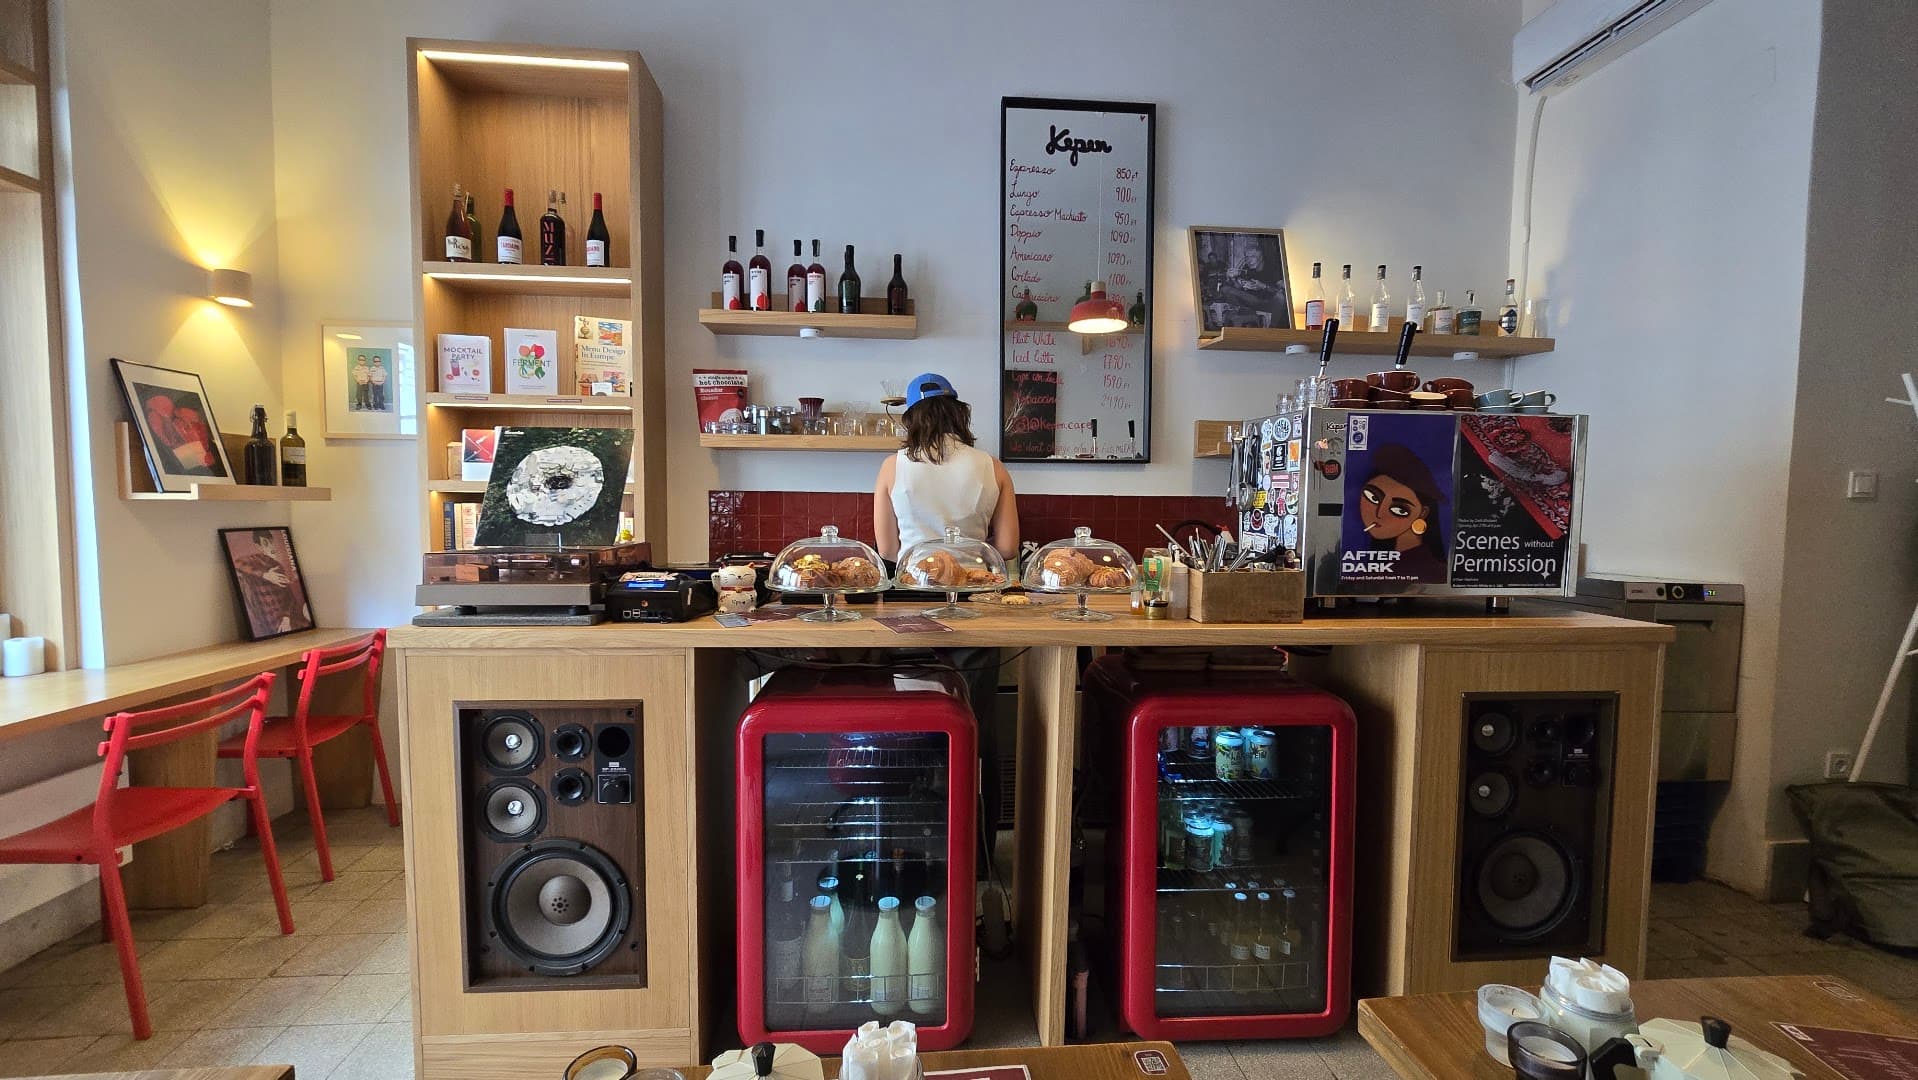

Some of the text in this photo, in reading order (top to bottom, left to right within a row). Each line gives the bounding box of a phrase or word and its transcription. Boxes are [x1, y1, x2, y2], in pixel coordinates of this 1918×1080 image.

[1045, 124, 1113, 167] Kepen
[1009, 158, 1056, 179] Espresso
[1116, 168, 1131, 180] 850
[1009, 181, 1040, 206] Lungo
[1115, 187, 1132, 203] 900
[1010, 204, 1054, 222] Espresso
[1114, 211, 1130, 226] 950
[1010, 224, 1042, 244] Doppio
[1110, 230, 1130, 243] 1090
[1010, 246, 1053, 262] Americano
[1011, 266, 1041, 283] Cortado
[1012, 331, 1056, 346] Flat White
[443, 347, 483, 355] MOCKTAIL
[1012, 350, 1030, 363] Iced
[512, 359, 552, 367] FERMENT
[1103, 353, 1124, 369] 1790
[1103, 375, 1122, 389] 1590
[1455, 531, 1554, 550] Scenes without
[1341, 550, 1401, 561] AFTER
[1453, 553, 1556, 574] Permission
[1341, 562, 1395, 573] DARK
